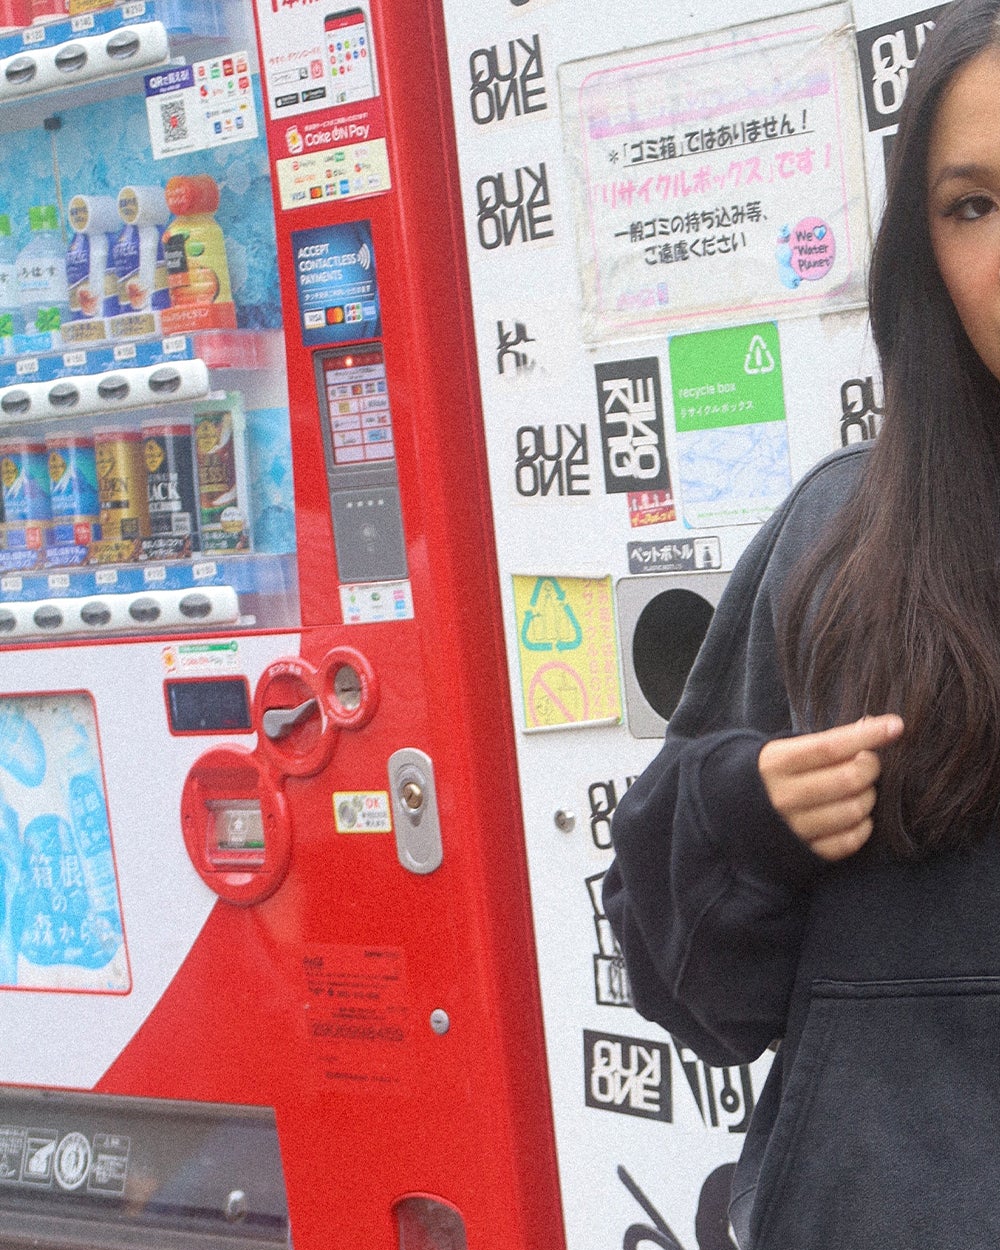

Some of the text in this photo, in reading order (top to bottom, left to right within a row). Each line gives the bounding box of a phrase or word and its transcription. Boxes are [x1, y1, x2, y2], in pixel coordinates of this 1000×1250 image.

[305, 131, 331, 146] Coke
[349, 124, 370, 139] Pay
[795, 231, 813, 243] We
[298, 243, 329, 259] ACCEPT
[644, 231, 747, 266] ご遠慮ください
[298, 253, 357, 272] CONTACTLESS
[300, 269, 343, 286] PAYMENTS
[678, 382, 737, 400] recycle box
[148, 481, 181, 501] ACK
[630, 543, 694, 563] ペットボトル
